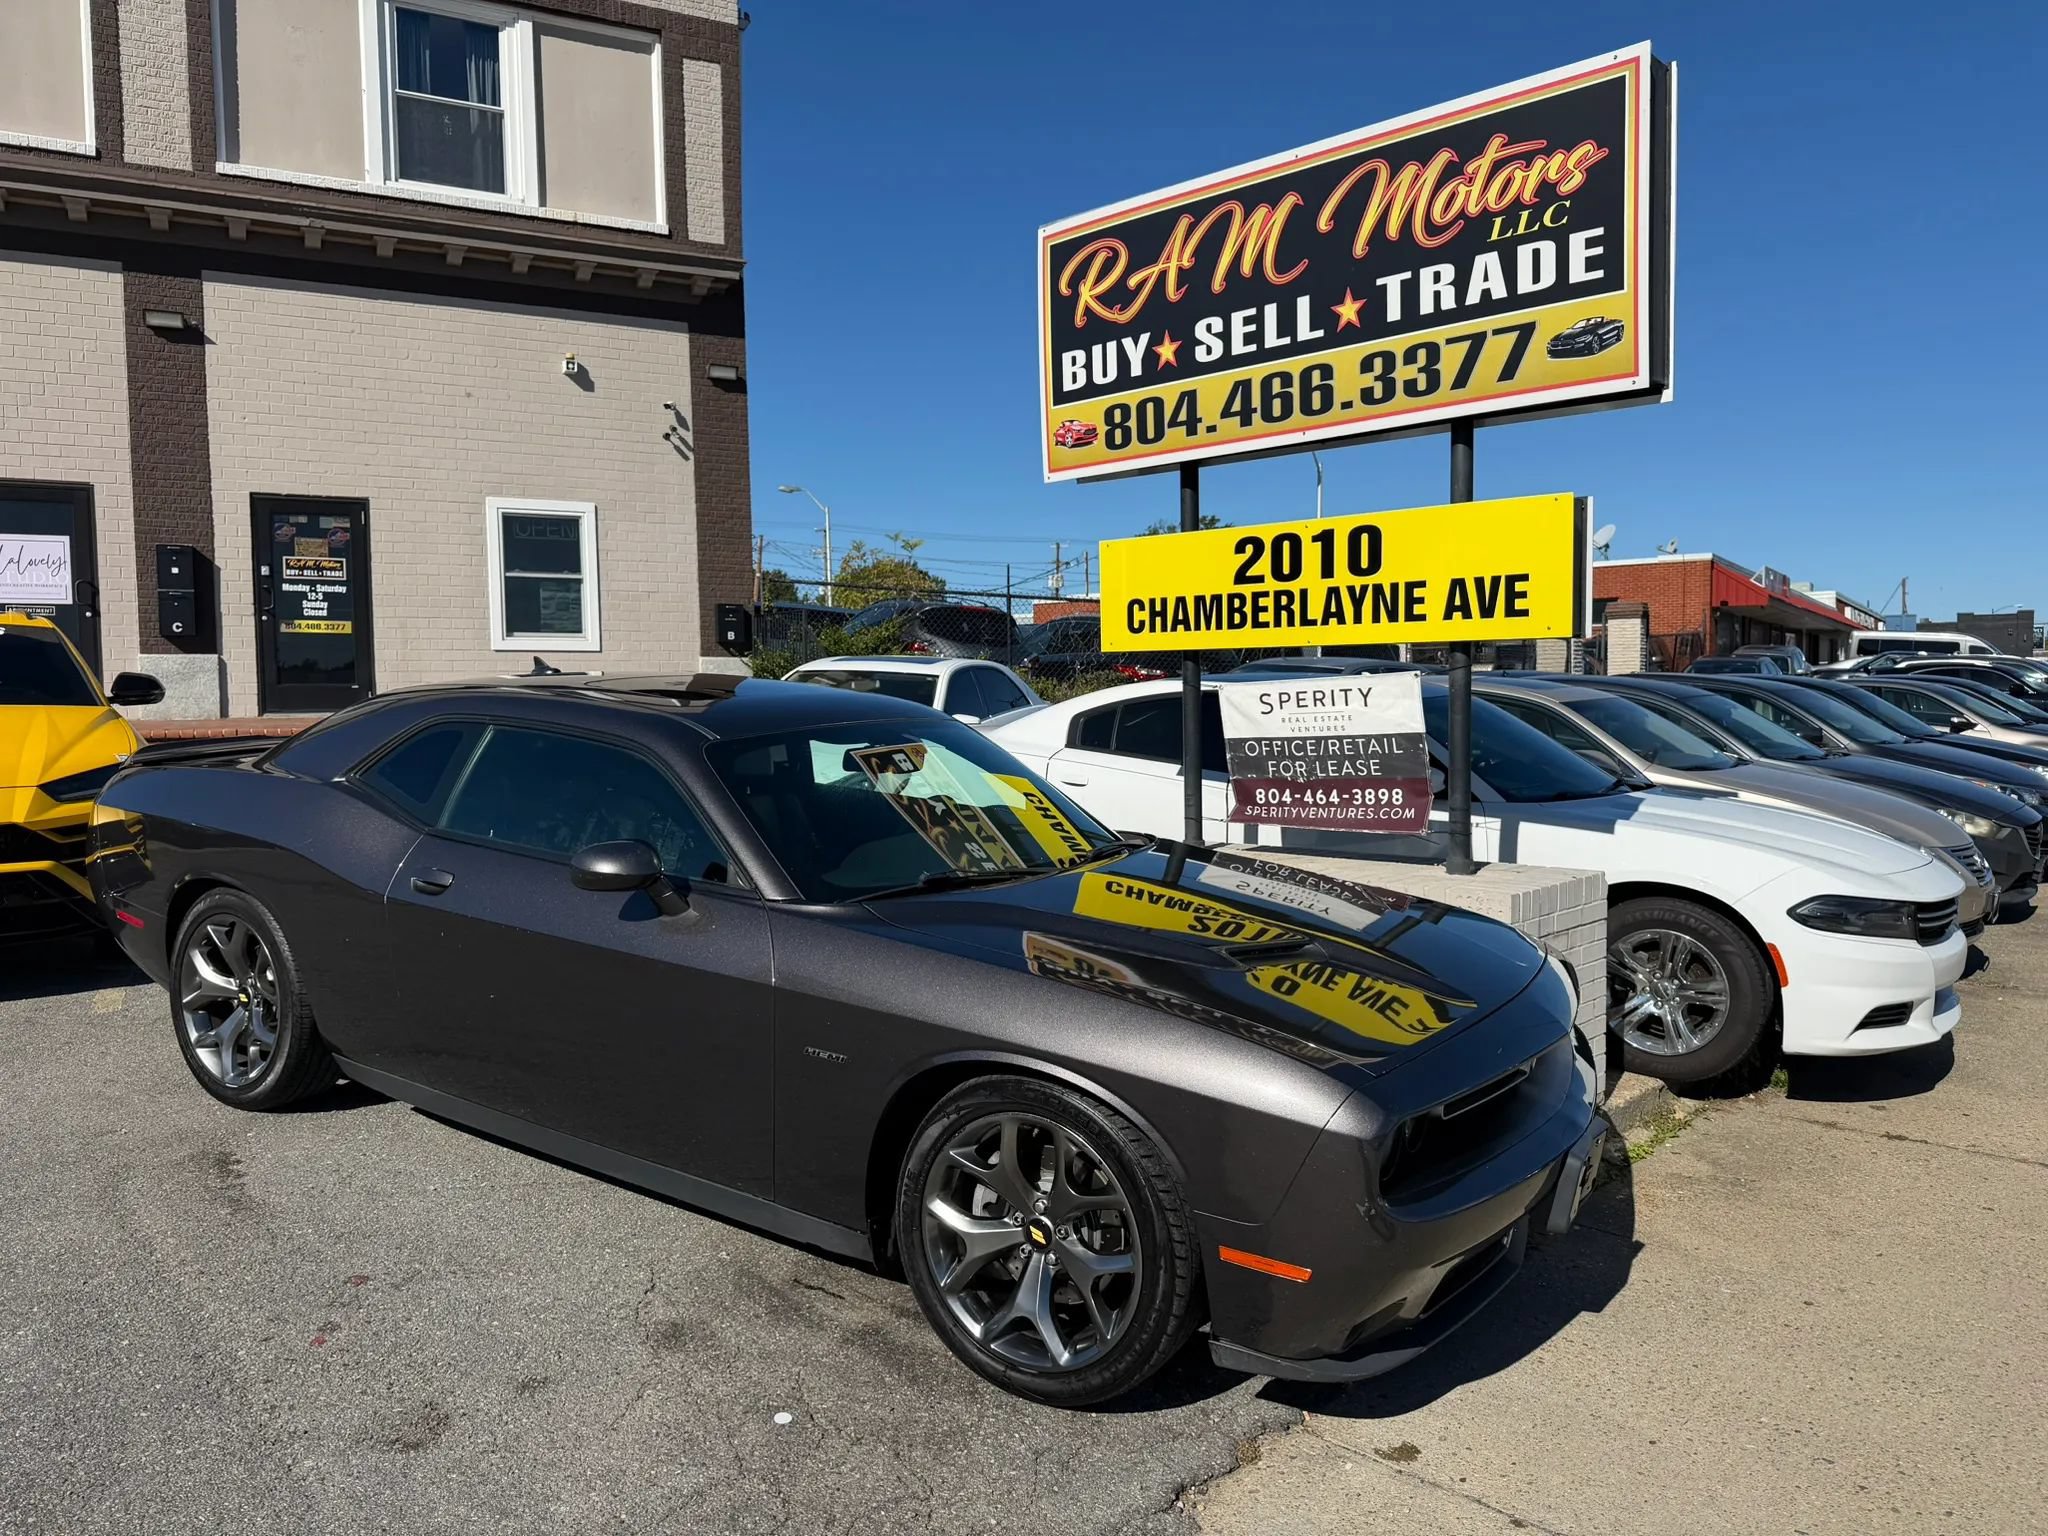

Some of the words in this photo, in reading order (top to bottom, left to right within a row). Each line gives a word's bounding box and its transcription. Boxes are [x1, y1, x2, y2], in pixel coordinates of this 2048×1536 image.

[1058, 191, 1309, 328] RAM
[1316, 133, 1609, 259] Motors
[1486, 200, 1571, 242] LLC
[1061, 331, 1151, 392] BUY
[1194, 294, 1325, 363] SELL
[1376, 226, 1605, 323] TRADE
[1104, 320, 1538, 451] 804.466.3377
[1233, 524, 1383, 585] 2010
[282, 583, 310, 592] Monday
[316, 584, 347, 593] Saturday
[302, 600, 328, 609] Sunday
[1126, 580, 1427, 634] CHAMBERLAYNE
[1442, 573, 1530, 621] AVE
[172, 622, 183, 633] C
[727, 631, 735, 640] B
[1259, 687, 1373, 714] SPERITY
[1290, 725, 1346, 733] VENTURES
[1244, 737, 1404, 757] OFFICE/RETAIL
[1268, 760, 1307, 777] FOR
[1315, 759, 1382, 777] LEASE
[1255, 788, 1404, 805] 804-464-3898
[1244, 805, 1415, 820] SPERITYVENTURES.COM
